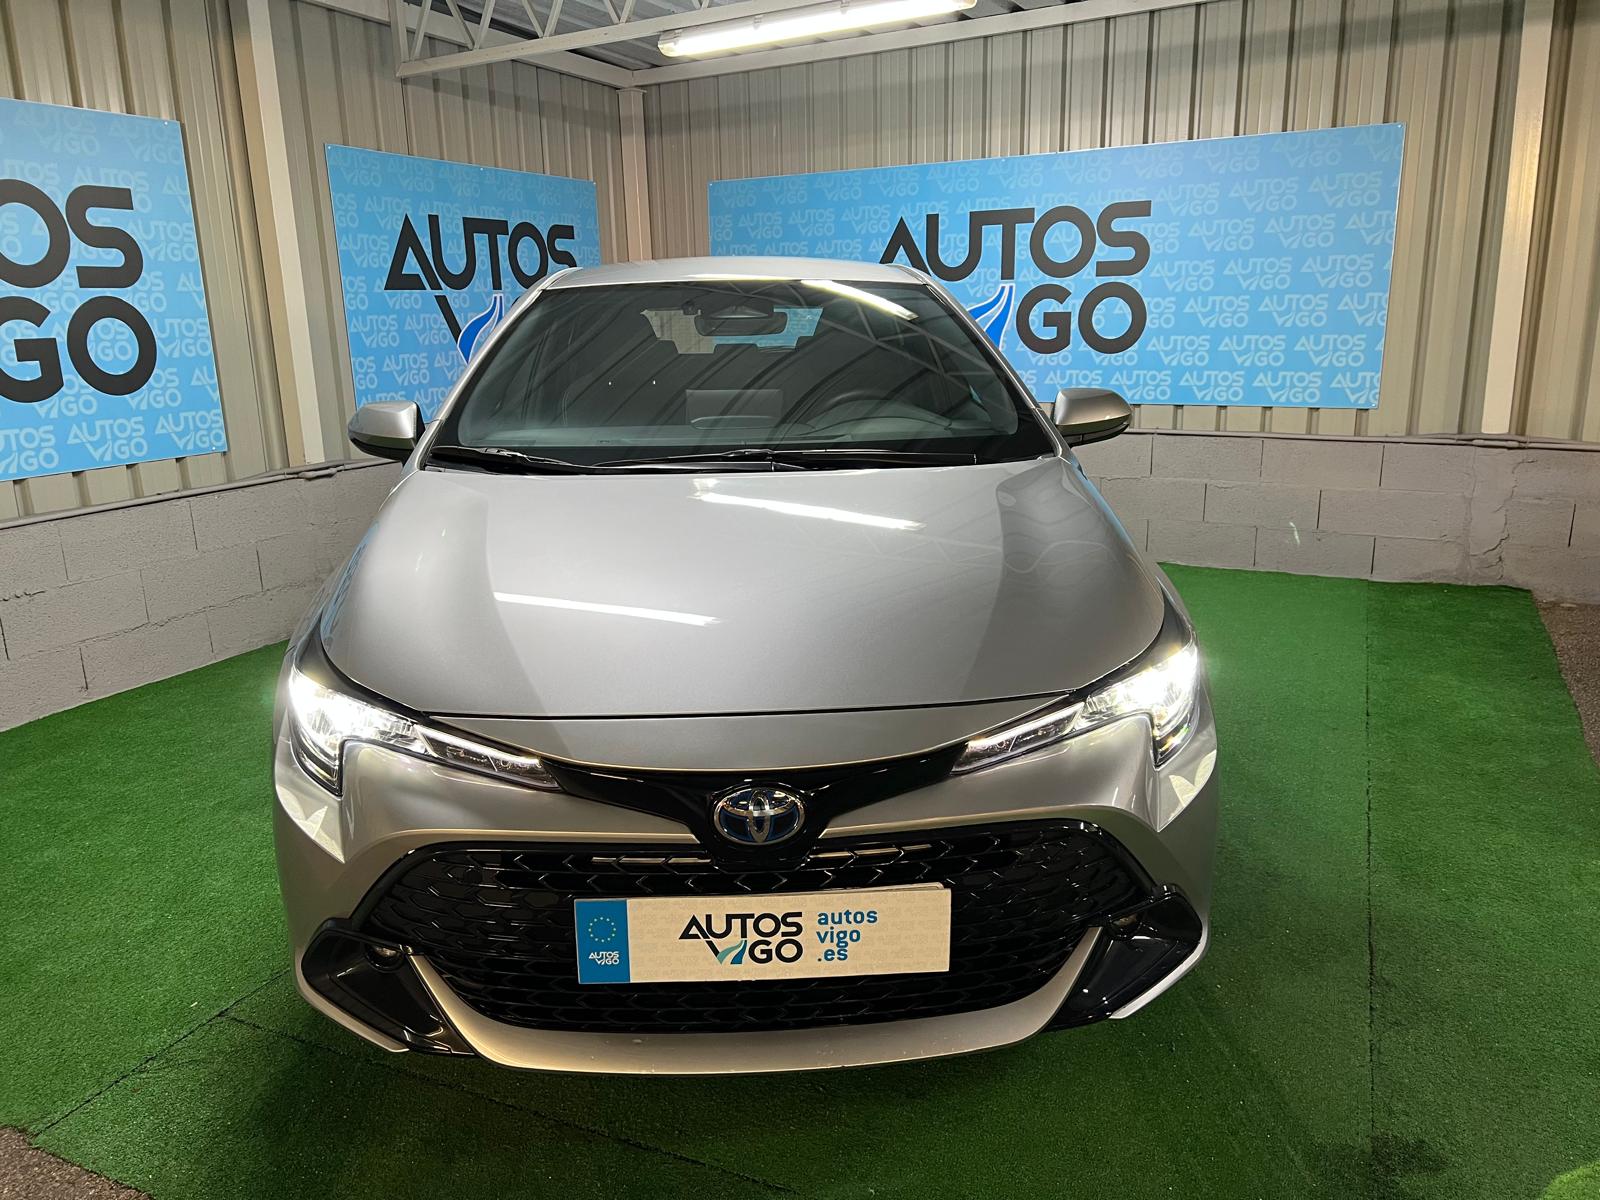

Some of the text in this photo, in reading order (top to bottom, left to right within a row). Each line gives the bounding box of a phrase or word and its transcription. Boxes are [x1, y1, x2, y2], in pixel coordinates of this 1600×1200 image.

[1206, 155, 1260, 174] VIGO
[1285, 149, 1342, 168] VIGO
[1065, 167, 1112, 184] VIGO
[1134, 161, 1184, 179] VIGO
[938, 177, 980, 192] VIGO
[1001, 172, 1044, 189] VIGO
[1229, 177, 1299, 197] AUTOS
[1309, 171, 1383, 192] AUTOS
[824, 186, 862, 200] VIGO
[881, 182, 920, 197] VIGO
[1157, 182, 1221, 202] AUTOS
[1242, 194, 1298, 212] VIGO
[1321, 189, 1381, 208] VIGO
[789, 208, 836, 224] AUTOS
[843, 204, 892, 220] AUTOS
[1168, 199, 1219, 216] VIGO
[739, 211, 783, 227] AUTOS
[852, 219, 891, 234] VIGO
[1189, 217, 1255, 236] AUTOS
[1265, 213, 1336, 233] AUTOS
[748, 224, 783, 239] VIGO
[799, 222, 836, 237] VIGO
[340, 233, 390, 252] AUTOS
[815, 238, 863, 254] AUTOS
[879, 200, 1152, 281] AUTOS
[1202, 234, 1255, 250] VIGO
[1279, 230, 1335, 248] VIGO
[385, 213, 576, 292] AUTOS
[764, 241, 809, 255] AUTOS
[1151, 258, 1215, 277] AUTOS
[1224, 257, 1293, 275] AUTOS
[1300, 253, 1375, 272] AUTOS
[1163, 275, 1215, 292] VIGO
[1237, 273, 1291, 290] VIGO
[1313, 270, 1372, 288] VIGO
[385, 293, 422, 310] VIGO
[1184, 295, 1250, 312] AUTOS
[1259, 293, 1329, 311] AUTOS
[350, 314, 398, 332] AUTOS
[1197, 312, 1249, 327] VIGO
[1272, 310, 1328, 327] VIGO
[360, 331, 400, 348] VIGO
[414, 328, 450, 346] VIGO
[1147, 334, 1211, 350] AUTOS
[1219, 333, 1287, 350] AUTOS
[1295, 333, 1367, 350] AUTOS
[382, 353, 429, 371] AUTOS
[1160, 350, 1210, 366] VIGO
[1232, 350, 1286, 367] VIGO
[1309, 350, 1366, 367] VIGO
[393, 369, 430, 386] VIGO
[1044, 369, 1103, 384] AUTOS
[1111, 369, 1172, 385] AUTOS
[1180, 370, 1245, 387] AUTOS
[1253, 371, 1323, 388] AUTOS
[1123, 384, 1172, 400] VIGO
[1193, 385, 1244, 401] VIGO
[1267, 386, 1321, 402] VIGO
[155, 408, 222, 435] AUTOS
[66, 417, 146, 444] AUTOS
[171, 429, 225, 451] VIGO
[84, 437, 148, 463] VIGO
[678, 911, 803, 940] AUTOS
[817, 909, 878, 926] autos
[816, 926, 862, 949] vigo
[588, 950, 620, 961] AUTOS
[705, 938, 804, 966] VIGO
[817, 945, 848, 962] .es
[597, 957, 620, 966] VIGO
